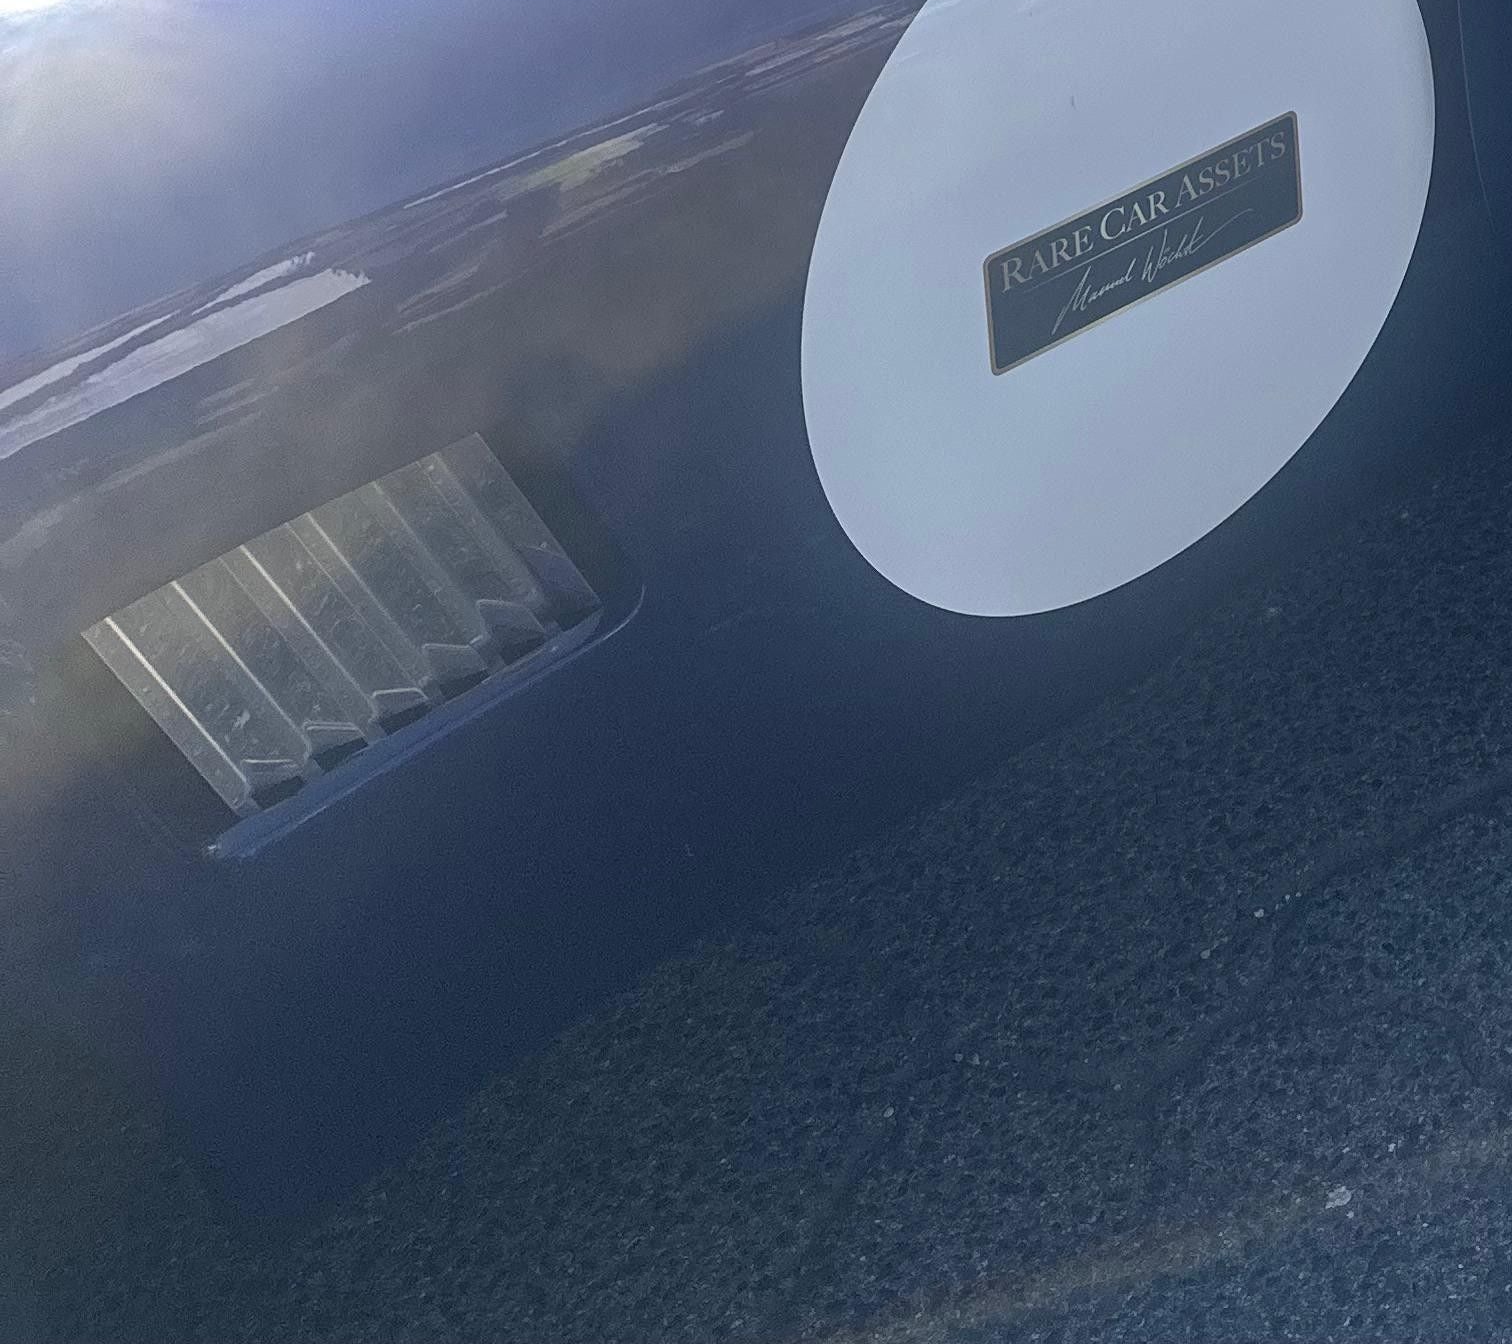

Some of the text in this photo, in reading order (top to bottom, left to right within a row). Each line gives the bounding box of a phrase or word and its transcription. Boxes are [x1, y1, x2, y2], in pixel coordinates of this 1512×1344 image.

[1000, 132, 1287, 294] RARE CAR ASSETS
